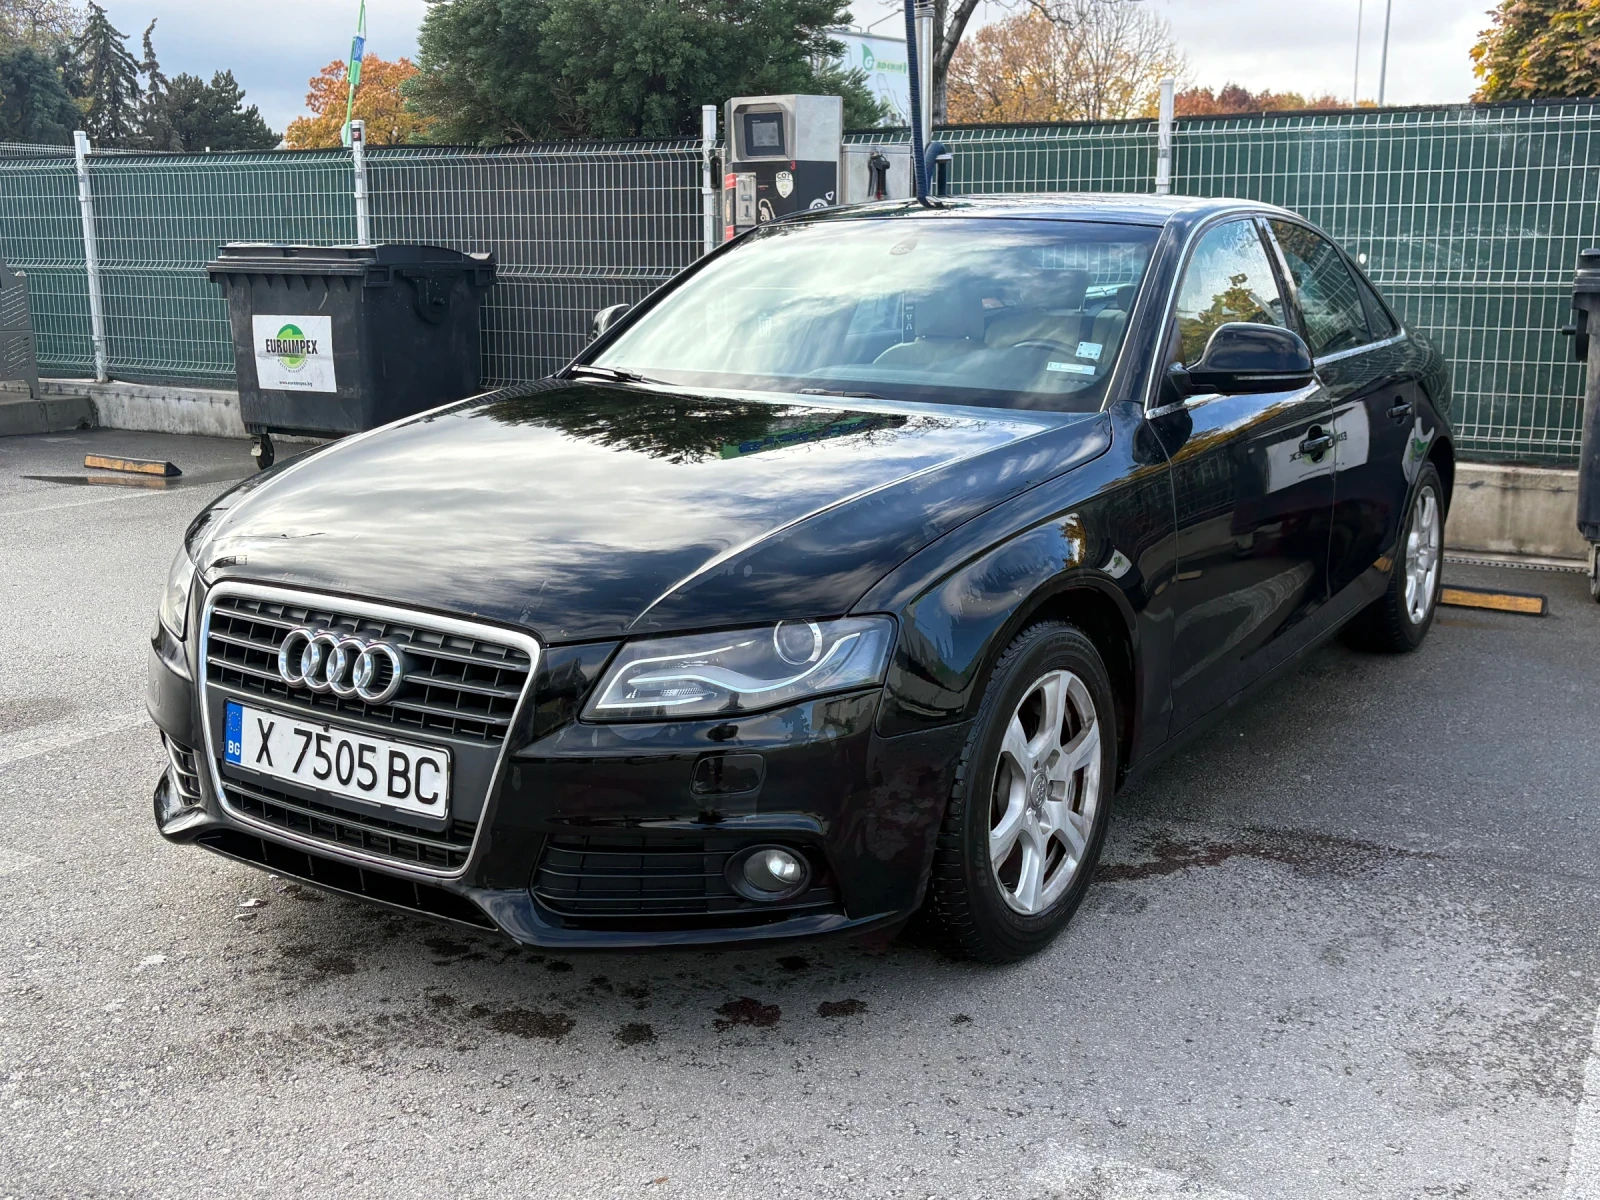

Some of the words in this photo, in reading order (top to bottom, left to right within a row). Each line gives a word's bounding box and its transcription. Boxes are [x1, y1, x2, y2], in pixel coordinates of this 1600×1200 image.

[266, 339, 318, 354] EUROIMPEX
[228, 740, 241, 756] BG
[255, 717, 275, 767] X
[291, 727, 378, 792] 7505
[387, 749, 441, 805] BC
